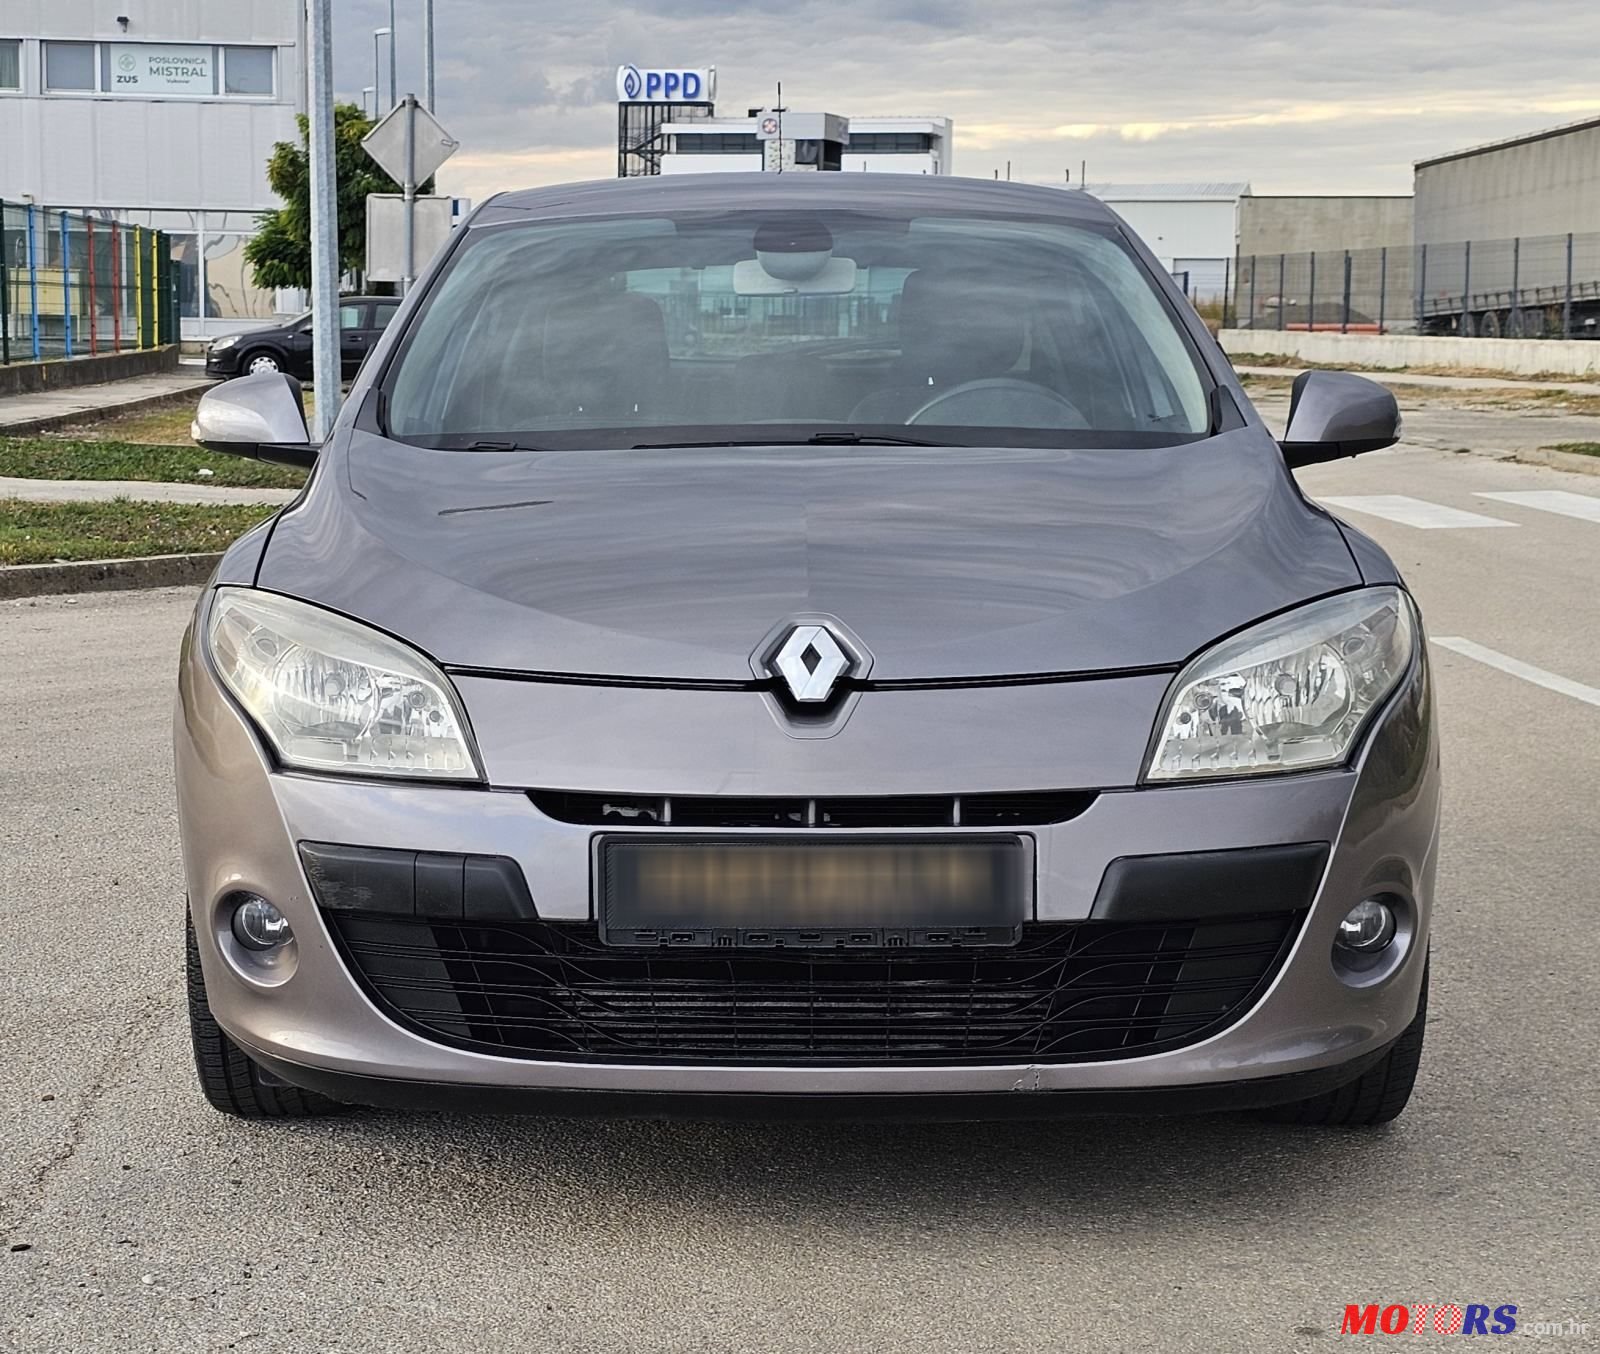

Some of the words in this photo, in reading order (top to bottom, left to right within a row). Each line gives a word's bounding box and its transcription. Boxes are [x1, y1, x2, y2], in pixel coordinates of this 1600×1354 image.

[148, 56, 207, 65] POSLOVNICA
[149, 66, 207, 77] MISTRAL
[116, 75, 139, 84] ZUS
[646, 72, 701, 99] PPD
